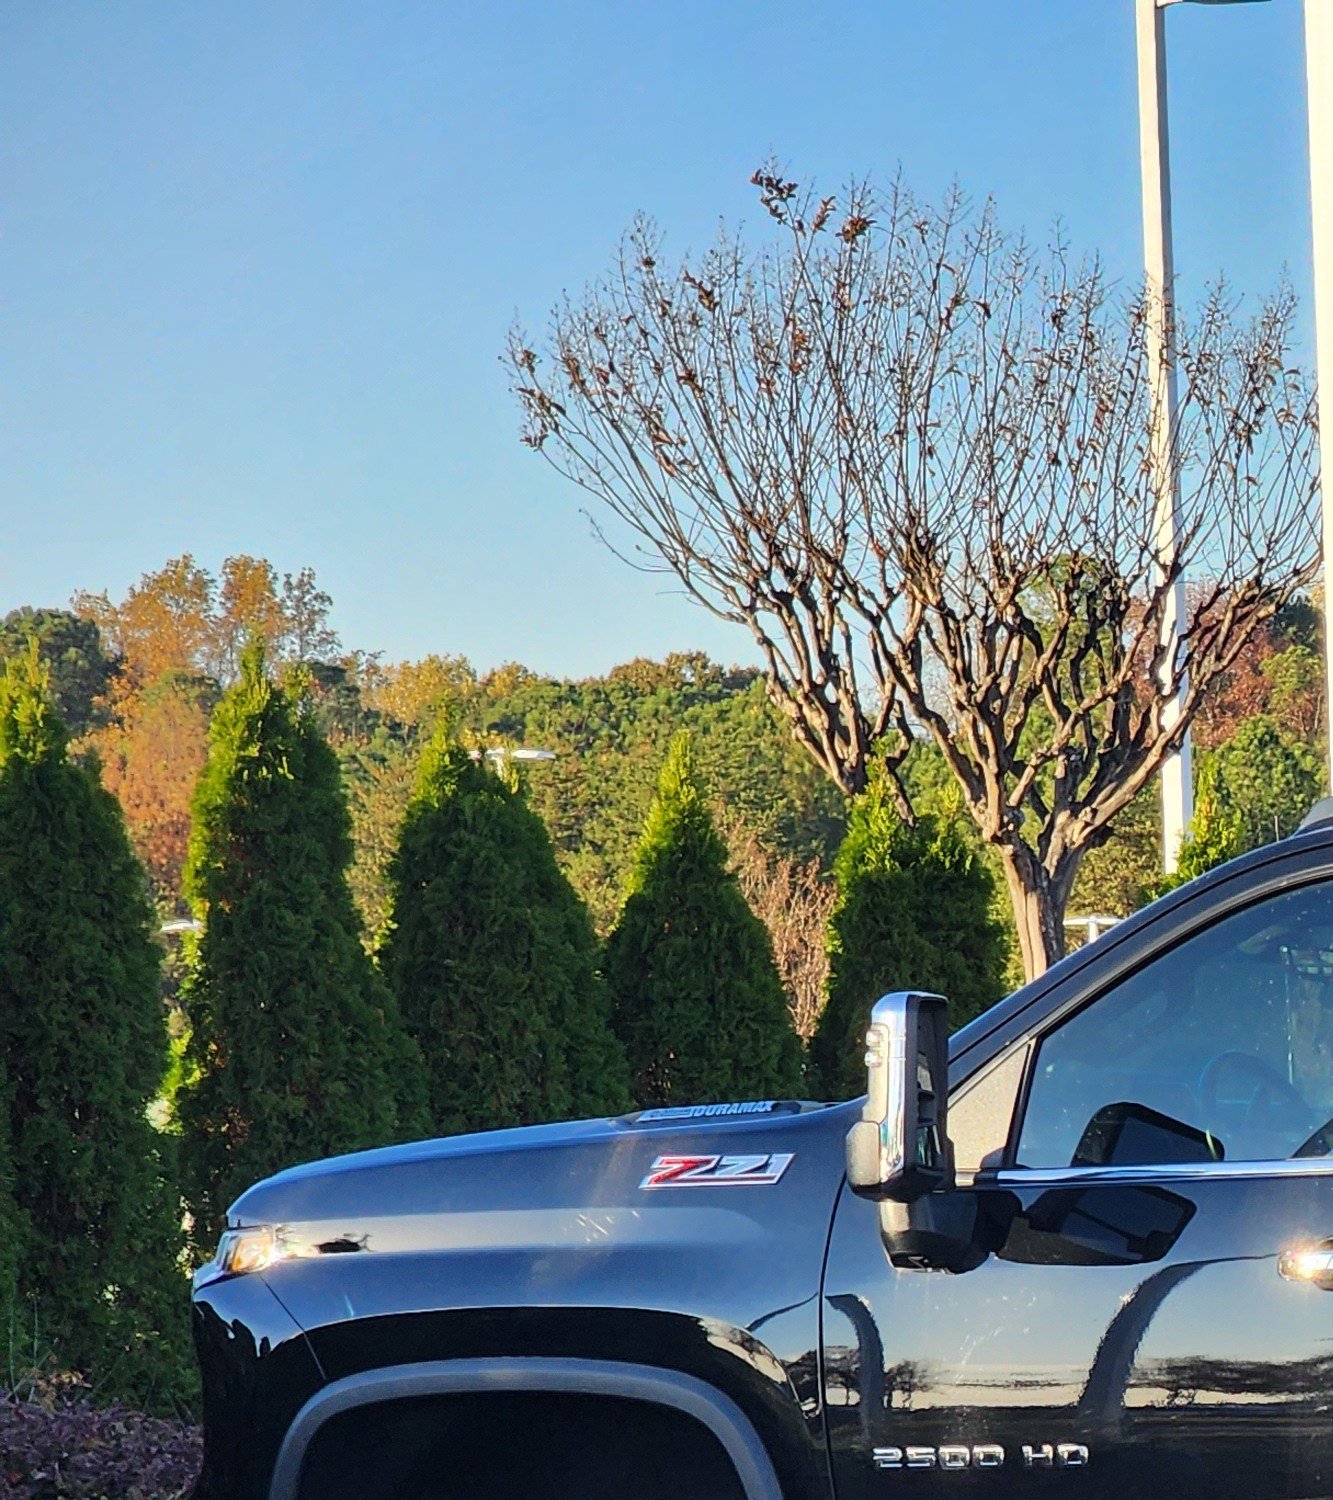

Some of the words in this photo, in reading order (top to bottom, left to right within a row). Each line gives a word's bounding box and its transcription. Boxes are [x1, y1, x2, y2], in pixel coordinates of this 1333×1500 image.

[692, 1100, 778, 1118] DURAMAX
[638, 1152, 797, 1190] Z71
[872, 1444, 1005, 1470] 2500
[1021, 1443, 1090, 1468] HD
